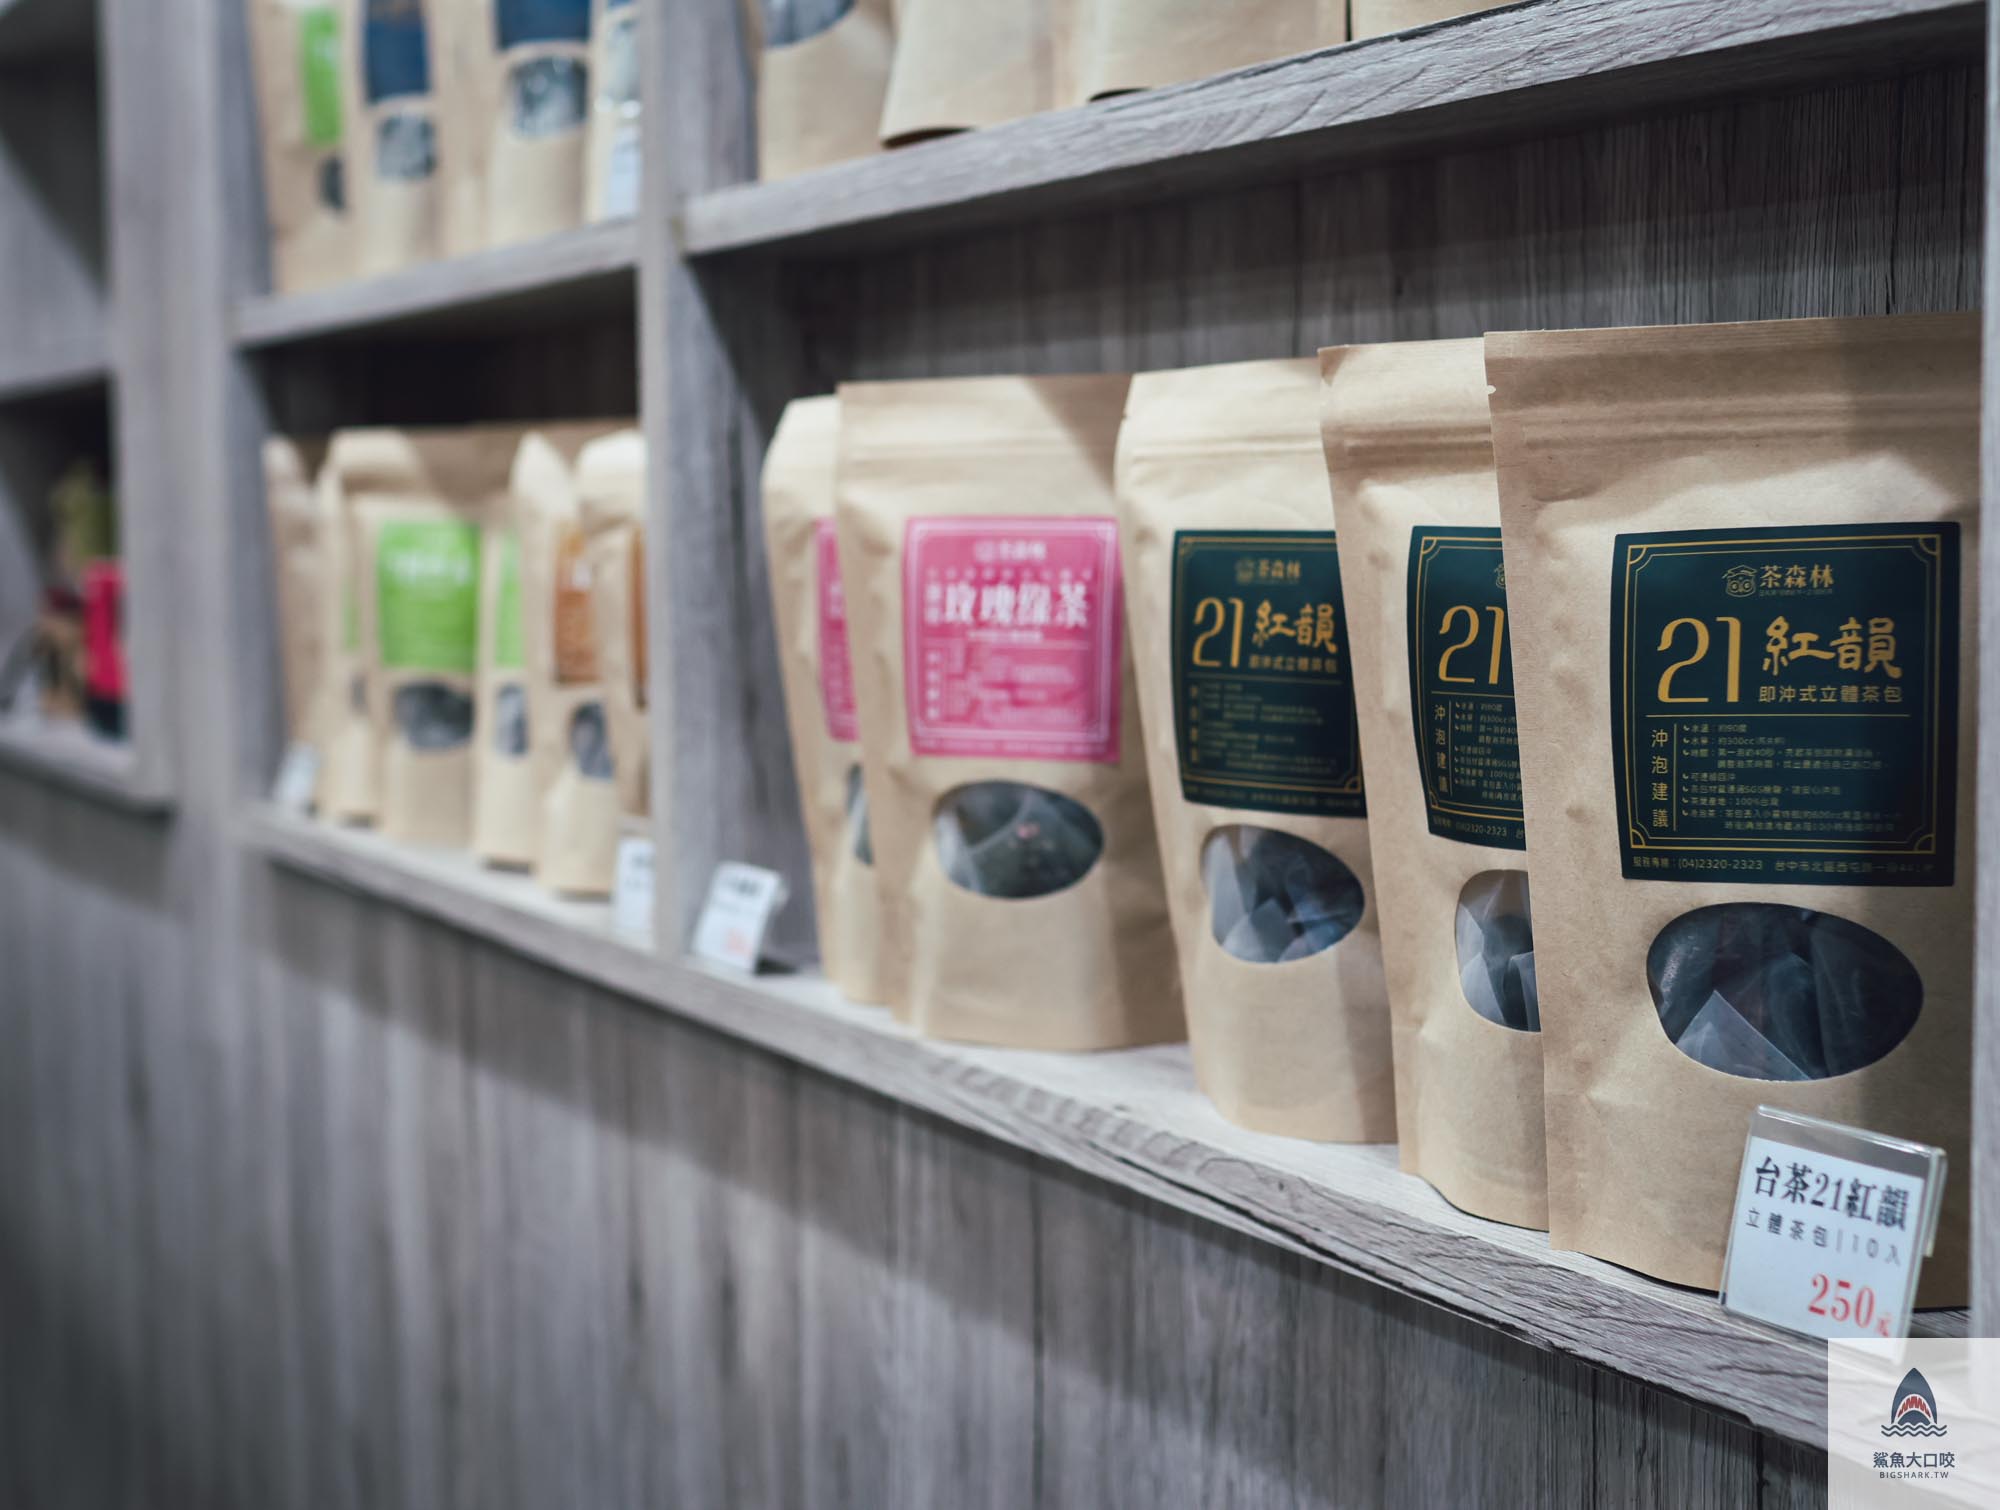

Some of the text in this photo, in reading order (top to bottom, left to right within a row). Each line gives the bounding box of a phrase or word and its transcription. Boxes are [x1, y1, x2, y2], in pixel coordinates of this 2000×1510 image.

[1759, 564, 1834, 588] 茶森林
[1193, 597, 1338, 668] 21 紅韻
[1438, 605, 1504, 684] 21
[1657, 615, 1903, 703] 21 紅韻
[1759, 685, 1903, 703] 即沖式立體茶包
[1651, 729, 1668, 829] 沖泡建議
[1755, 1156, 1909, 1232] 台茶21紅韻
